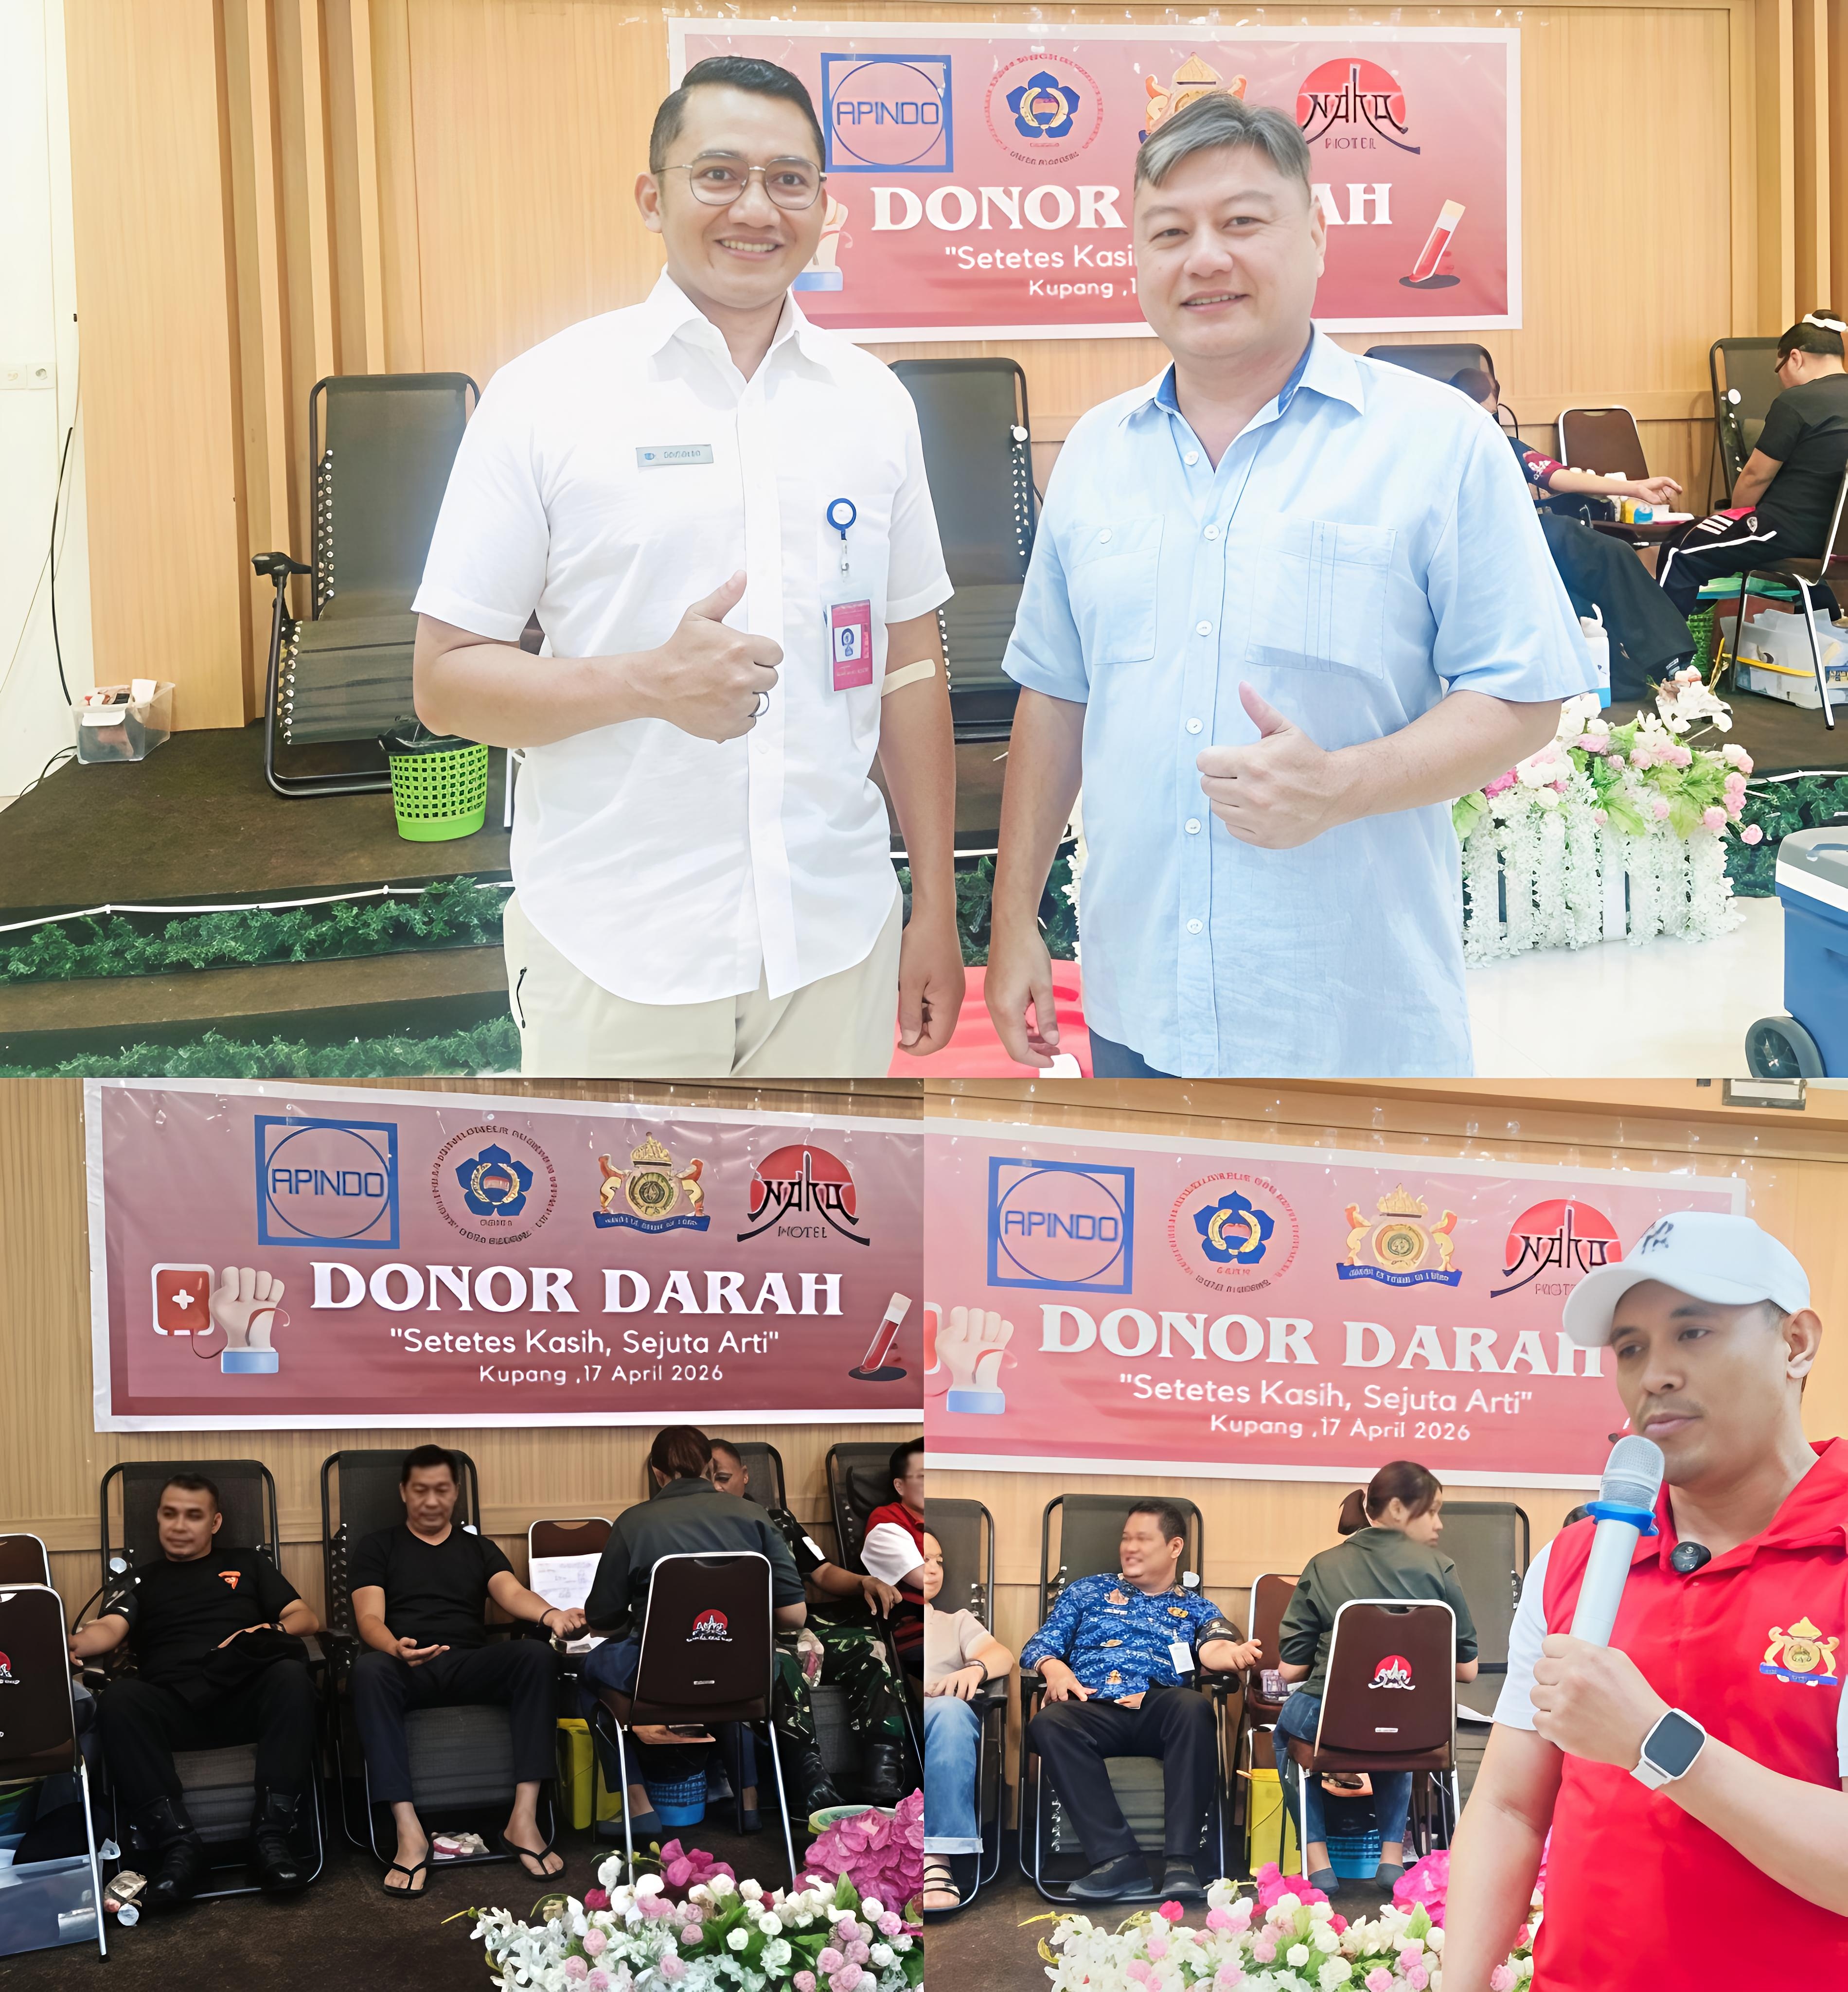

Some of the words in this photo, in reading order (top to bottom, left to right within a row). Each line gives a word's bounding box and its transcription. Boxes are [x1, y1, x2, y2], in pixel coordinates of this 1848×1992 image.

[837, 101, 939, 125] APINDO
[870, 185, 1127, 231] DONOR
[945, 246, 1064, 269] "Setetes
[1074, 244, 1133, 267] Kasi
[1030, 279, 1113, 299] Kupang
[1122, 277, 1137, 297] ,1
[272, 1168, 384, 1197] APINDO
[1005, 1210, 1118, 1242] APINDO
[309, 1262, 580, 1313] DONOR
[602, 1269, 844, 1315] DARAH
[391, 1328, 516, 1353] "Setetes
[526, 1329, 611, 1357] Kasih,
[623, 1330, 709, 1359] Sejuta
[718, 1331, 779, 1353] Arti"
[1038, 1304, 1319, 1365] DONOR
[1342, 1321, 1605, 1377] DARAH
[480, 1365, 566, 1386] Kupang
[576, 1365, 602, 1384] ,17
[611, 1365, 662, 1385] April
[672, 1365, 723, 1381] 2026
[1120, 1373, 1250, 1404] "Setetes
[1261, 1380, 1351, 1411] Kasih,
[1364, 1385, 1457, 1416] Sejuta
[1465, 1388, 1533, 1415] Arti"
[1211, 1414, 1303, 1439] Kupang
[1312, 1418, 1341, 1438] ,17
[1350, 1419, 1406, 1441] April
[1414, 1422, 1471, 1441] 2026
